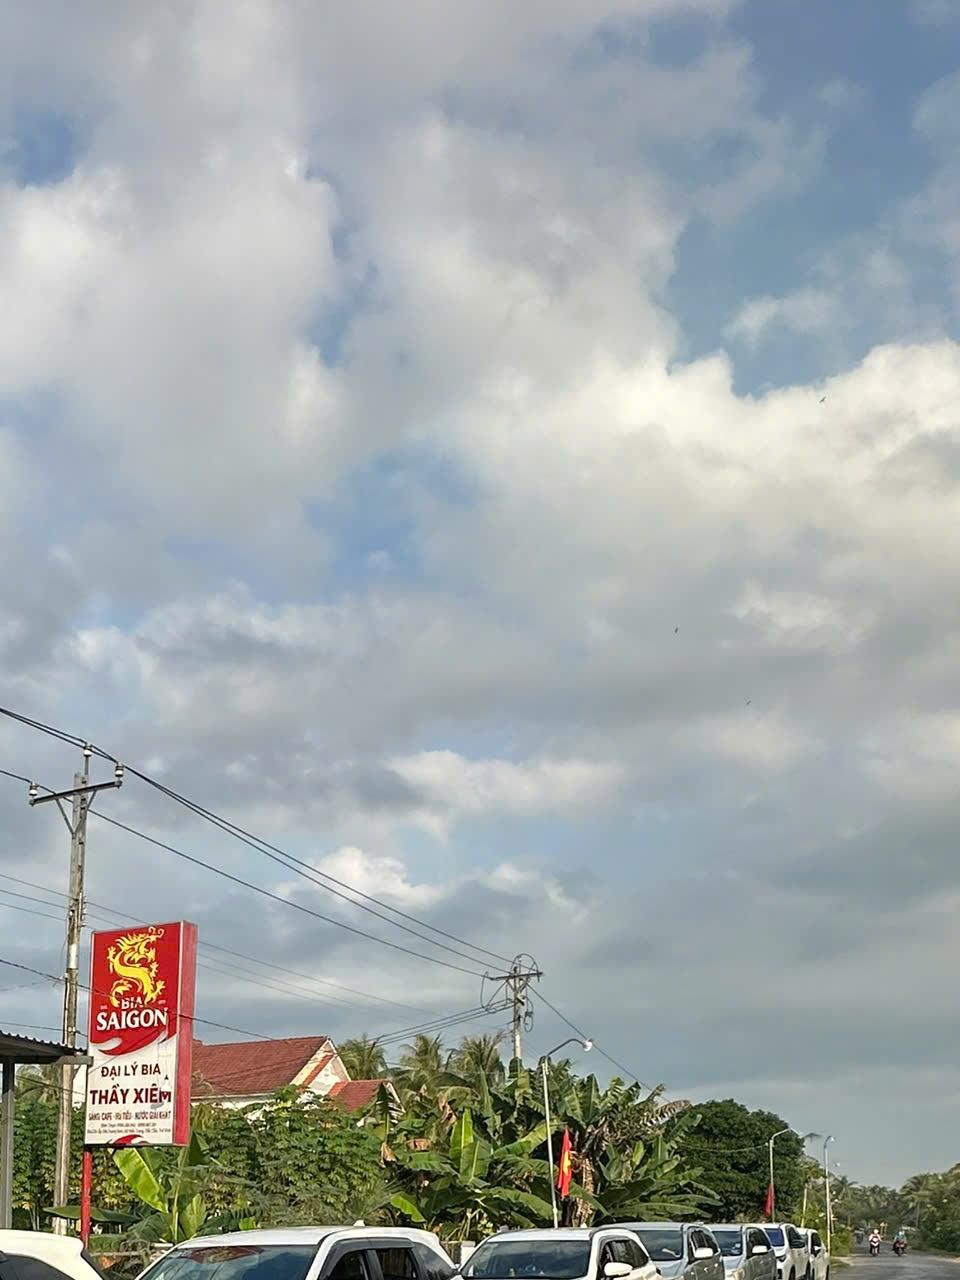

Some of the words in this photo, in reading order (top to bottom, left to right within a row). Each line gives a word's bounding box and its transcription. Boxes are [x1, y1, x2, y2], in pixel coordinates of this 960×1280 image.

[121, 996, 144, 1010] BIA
[96, 1006, 169, 1031] SAIGON
[101, 1065, 121, 1081] ĐẠI
[124, 1061, 139, 1076] LÝ
[141, 1063, 161, 1075] BIA
[89, 1083, 130, 1105] THẦY
[133, 1082, 172, 1104] XIÊM
